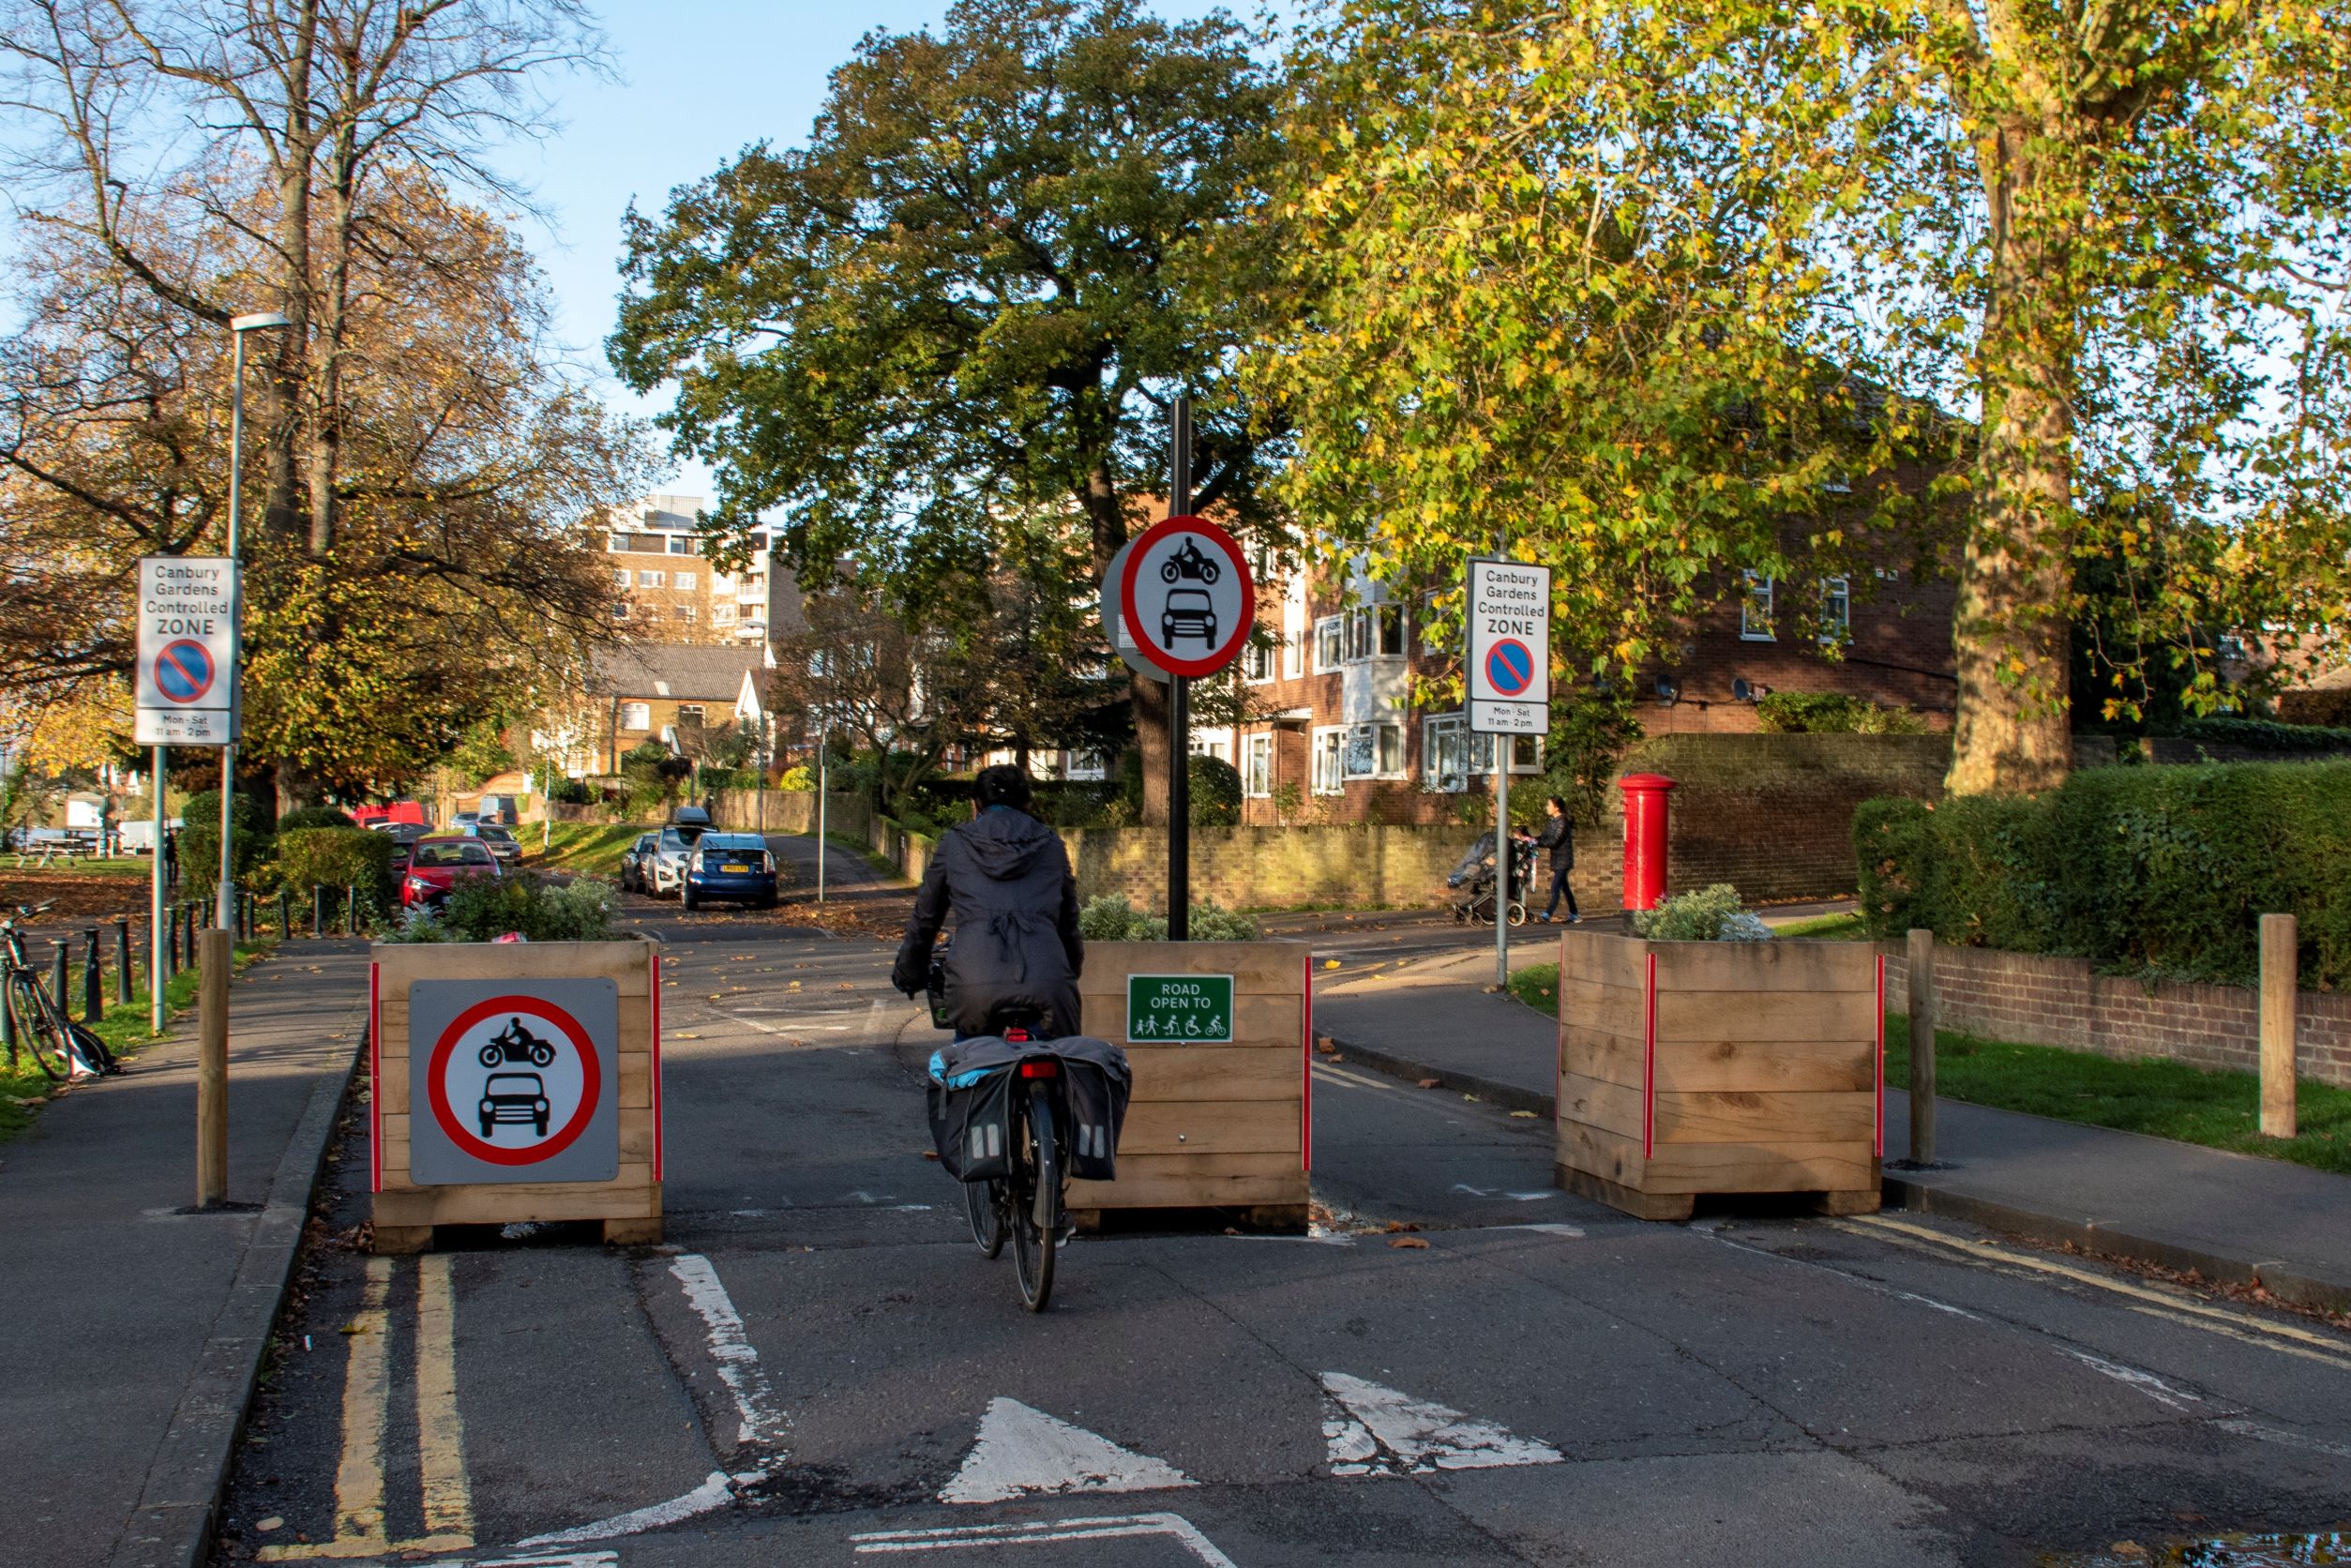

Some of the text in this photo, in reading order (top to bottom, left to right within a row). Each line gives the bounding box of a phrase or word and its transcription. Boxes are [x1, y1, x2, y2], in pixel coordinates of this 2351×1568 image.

[155, 565, 219, 580] Canbury
[1486, 570, 1538, 586] Canbury
[156, 583, 218, 596] Gardens
[1486, 586, 1537, 600] Gardens
[146, 600, 228, 614] Controlled
[1478, 602, 1545, 617] Controlled
[158, 619, 214, 635] ZONE
[1488, 619, 1534, 636] ZONE
[1494, 707, 1511, 716] Mon
[163, 716, 184, 724] Mon
[191, 716, 207, 725] Sat
[1162, 984, 1200, 995] ROAD
[1151, 997, 1211, 1009] OPEN TO
